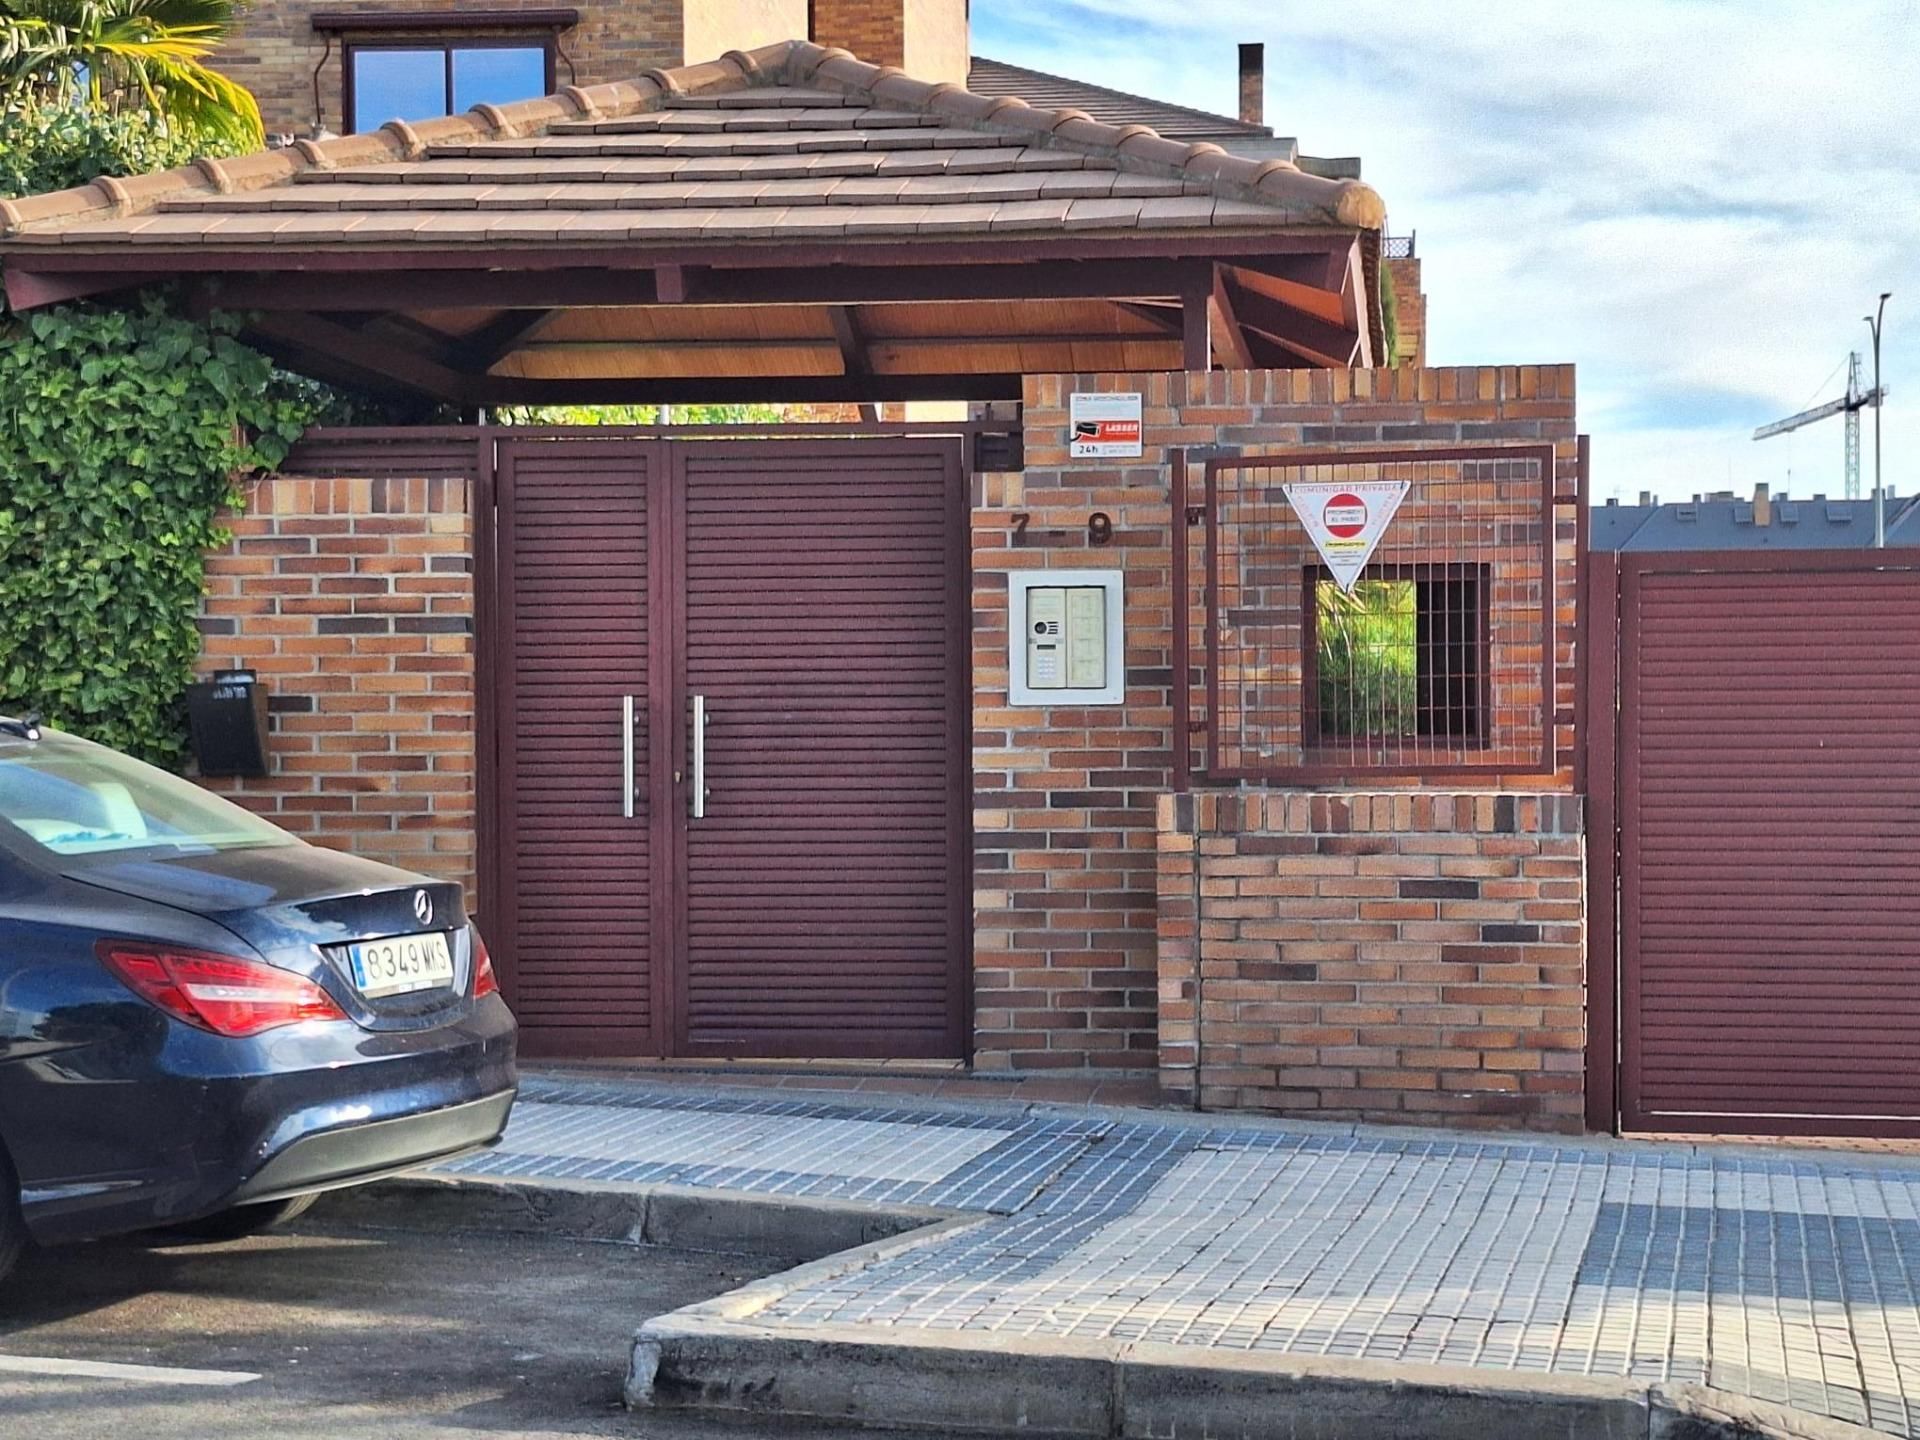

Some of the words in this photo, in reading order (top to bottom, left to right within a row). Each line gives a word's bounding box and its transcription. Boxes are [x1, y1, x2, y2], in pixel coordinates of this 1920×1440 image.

[1079, 445, 1098, 454] 24h
[1010, 513, 1030, 543] 7
[1088, 512, 1112, 545] 9
[367, 943, 421, 980] 8349
[421, 940, 447, 971] MKS
